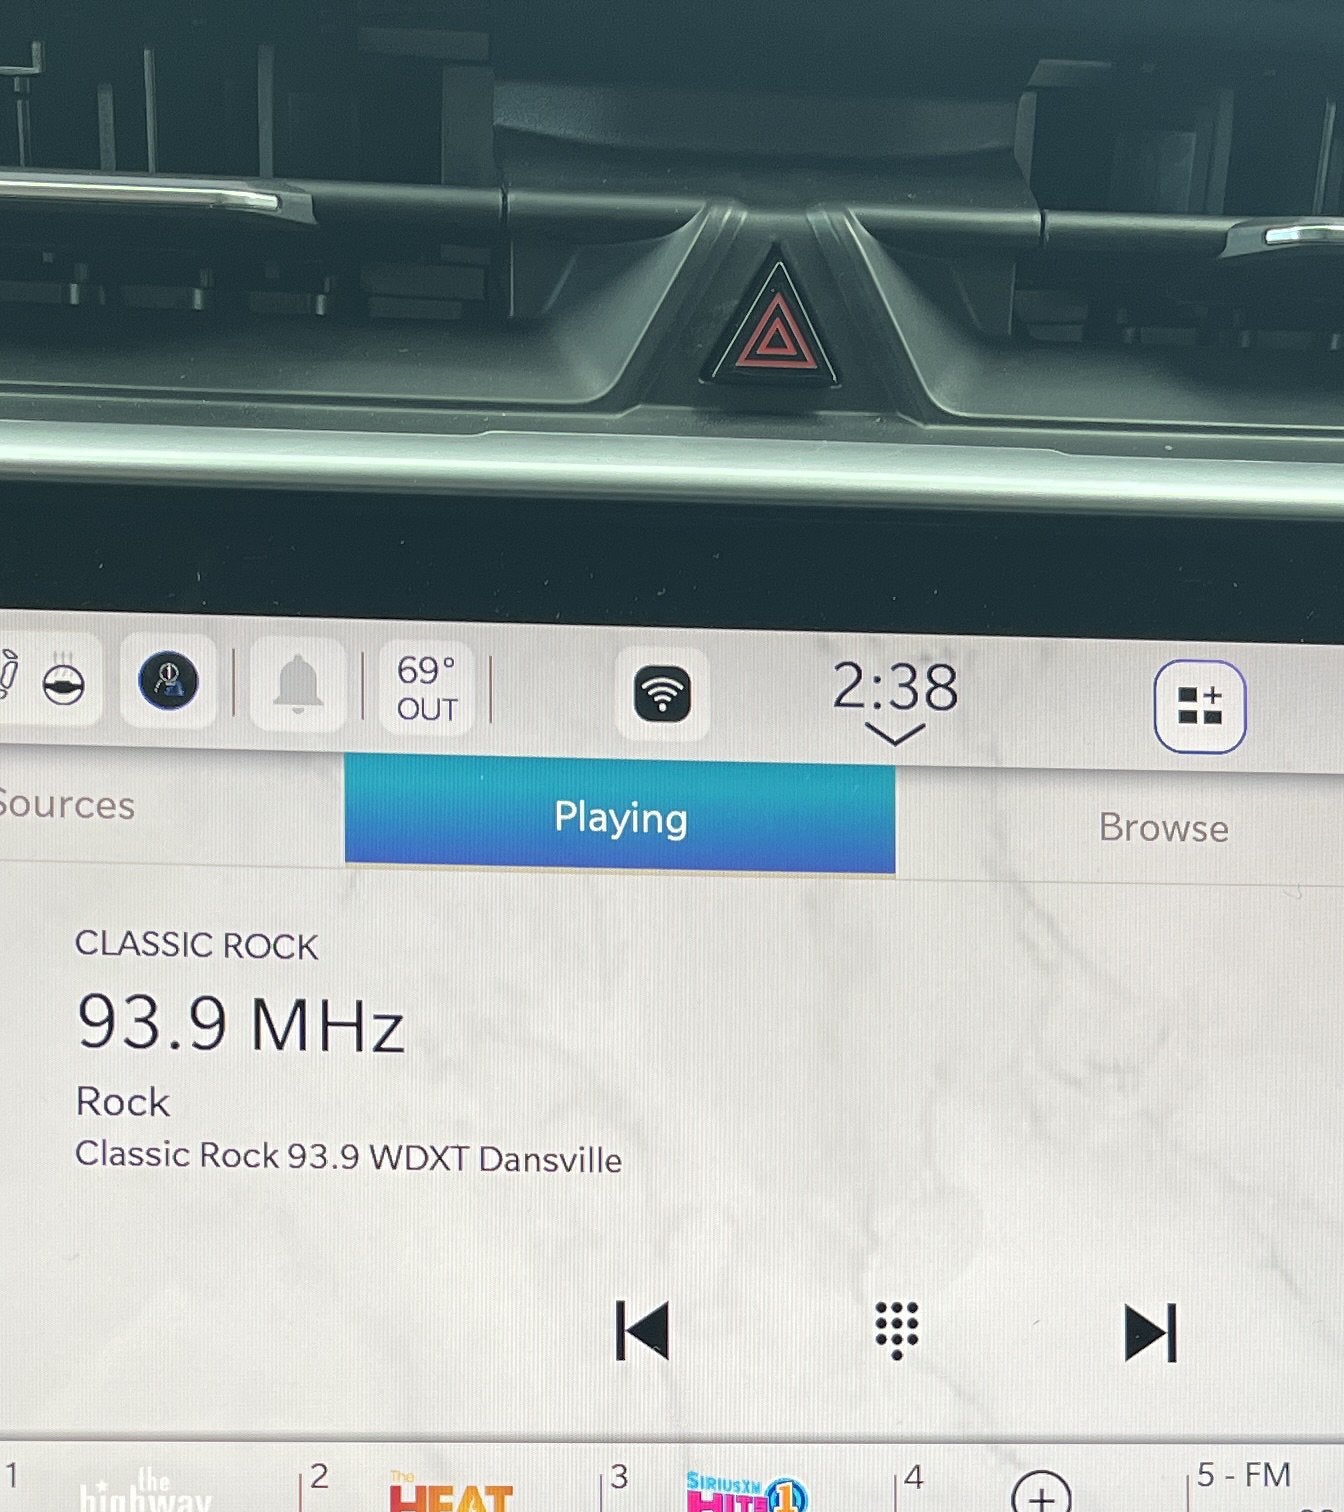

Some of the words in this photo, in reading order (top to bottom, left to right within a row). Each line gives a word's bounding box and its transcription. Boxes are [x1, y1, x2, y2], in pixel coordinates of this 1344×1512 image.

[397, 655, 455, 685] 69°
[833, 660, 958, 712] 2:38
[397, 696, 459, 722] OUT
[556, 800, 688, 841] Playing
[1100, 811, 1229, 843] Browse
[74, 929, 213, 958] CLASSIC
[224, 932, 319, 961] ROCK
[79, 992, 226, 1051] 93.9
[254, 997, 405, 1053] MHz
[77, 1085, 171, 1118] Rock
[75, 1138, 190, 1168] Classic
[200, 1141, 280, 1169] Rock
[287, 1142, 360, 1170] 93.9
[369, 1144, 471, 1172] WDXT
[480, 1145, 623, 1174] Dansville
[6, 1461, 16, 1489] 1
[137, 1466, 170, 1492] the
[310, 1462, 329, 1489] 2
[610, 1463, 629, 1490] 3
[903, 1463, 924, 1490] 4
[1197, 1461, 1215, 1488] 5
[1246, 1461, 1291, 1488] FM
